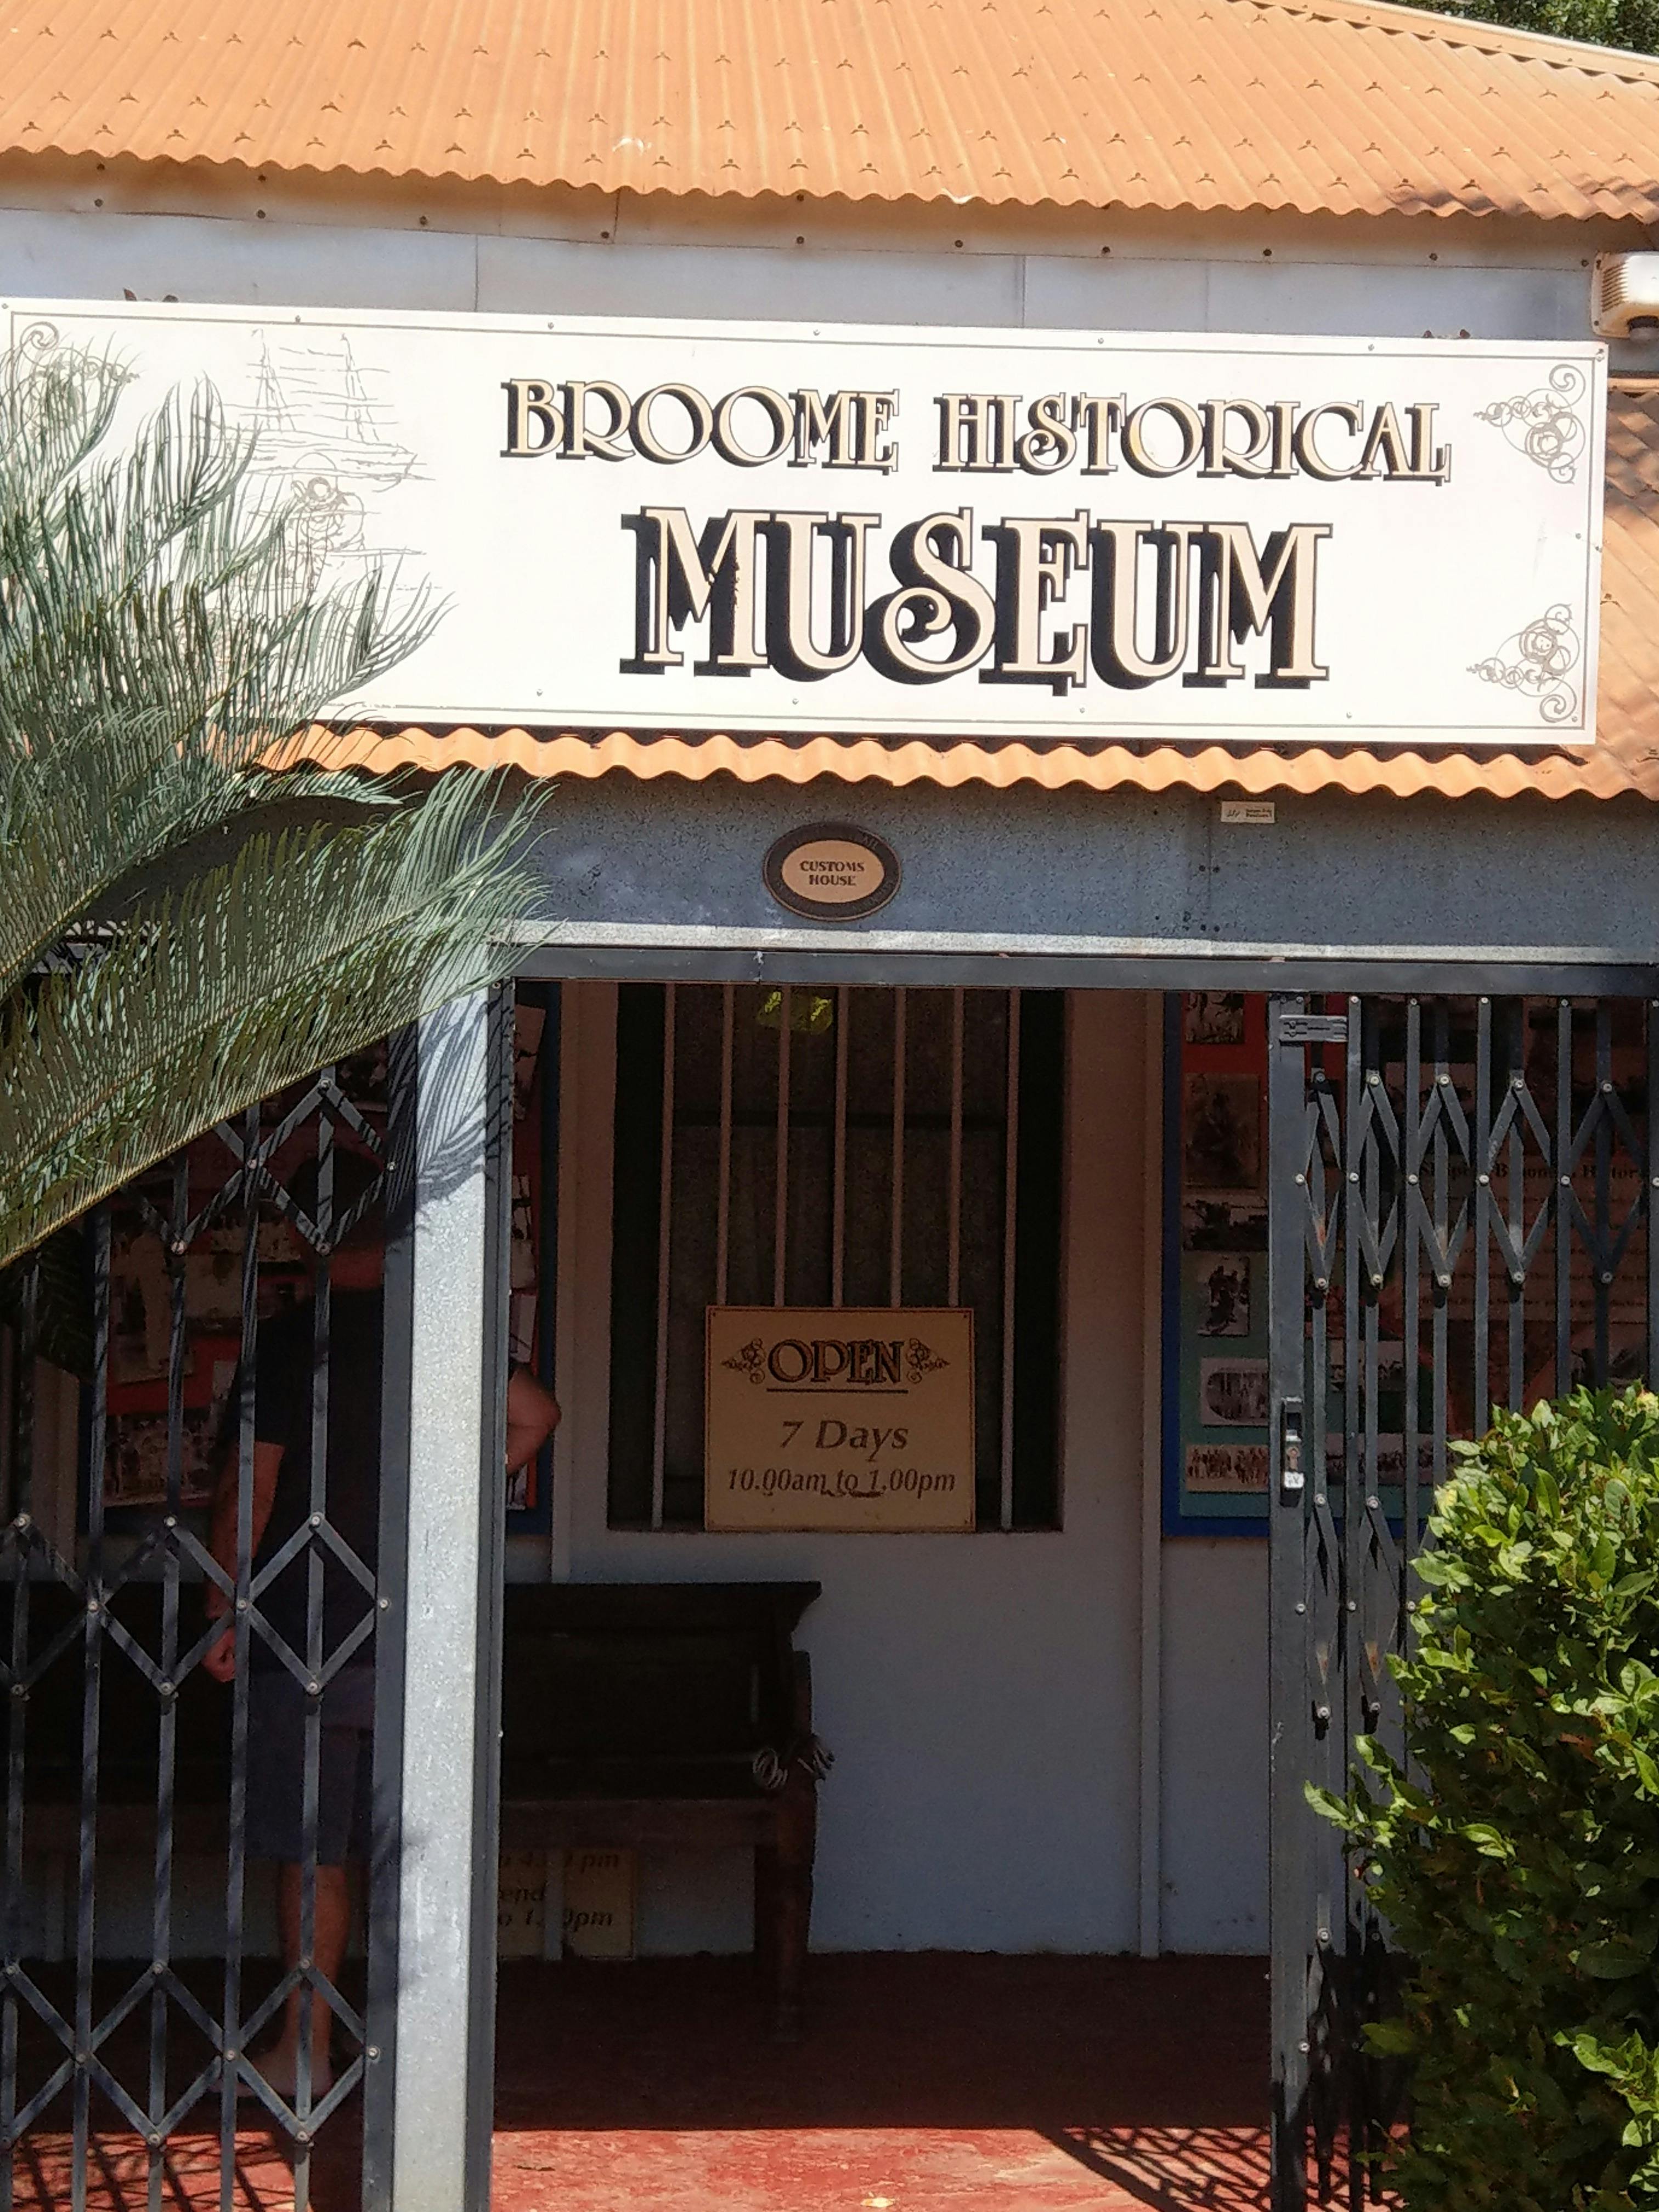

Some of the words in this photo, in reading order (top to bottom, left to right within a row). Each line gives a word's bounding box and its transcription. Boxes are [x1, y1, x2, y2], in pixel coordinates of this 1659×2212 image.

[500, 379, 899, 476] BROOME
[933, 393, 1451, 487] HISTORICAL
[619, 506, 1333, 697] MUSEUM
[800, 860, 865, 872] CUSTOMS
[809, 874, 856, 886] HOUSE
[768, 1339, 905, 1385] OPEN
[780, 1420, 804, 1448] 7
[815, 1420, 910, 1463] Days
[729, 1468, 826, 1493] 10.00am
[837, 1470, 858, 1491] to
[869, 1469, 956, 1499] 1.00pm
